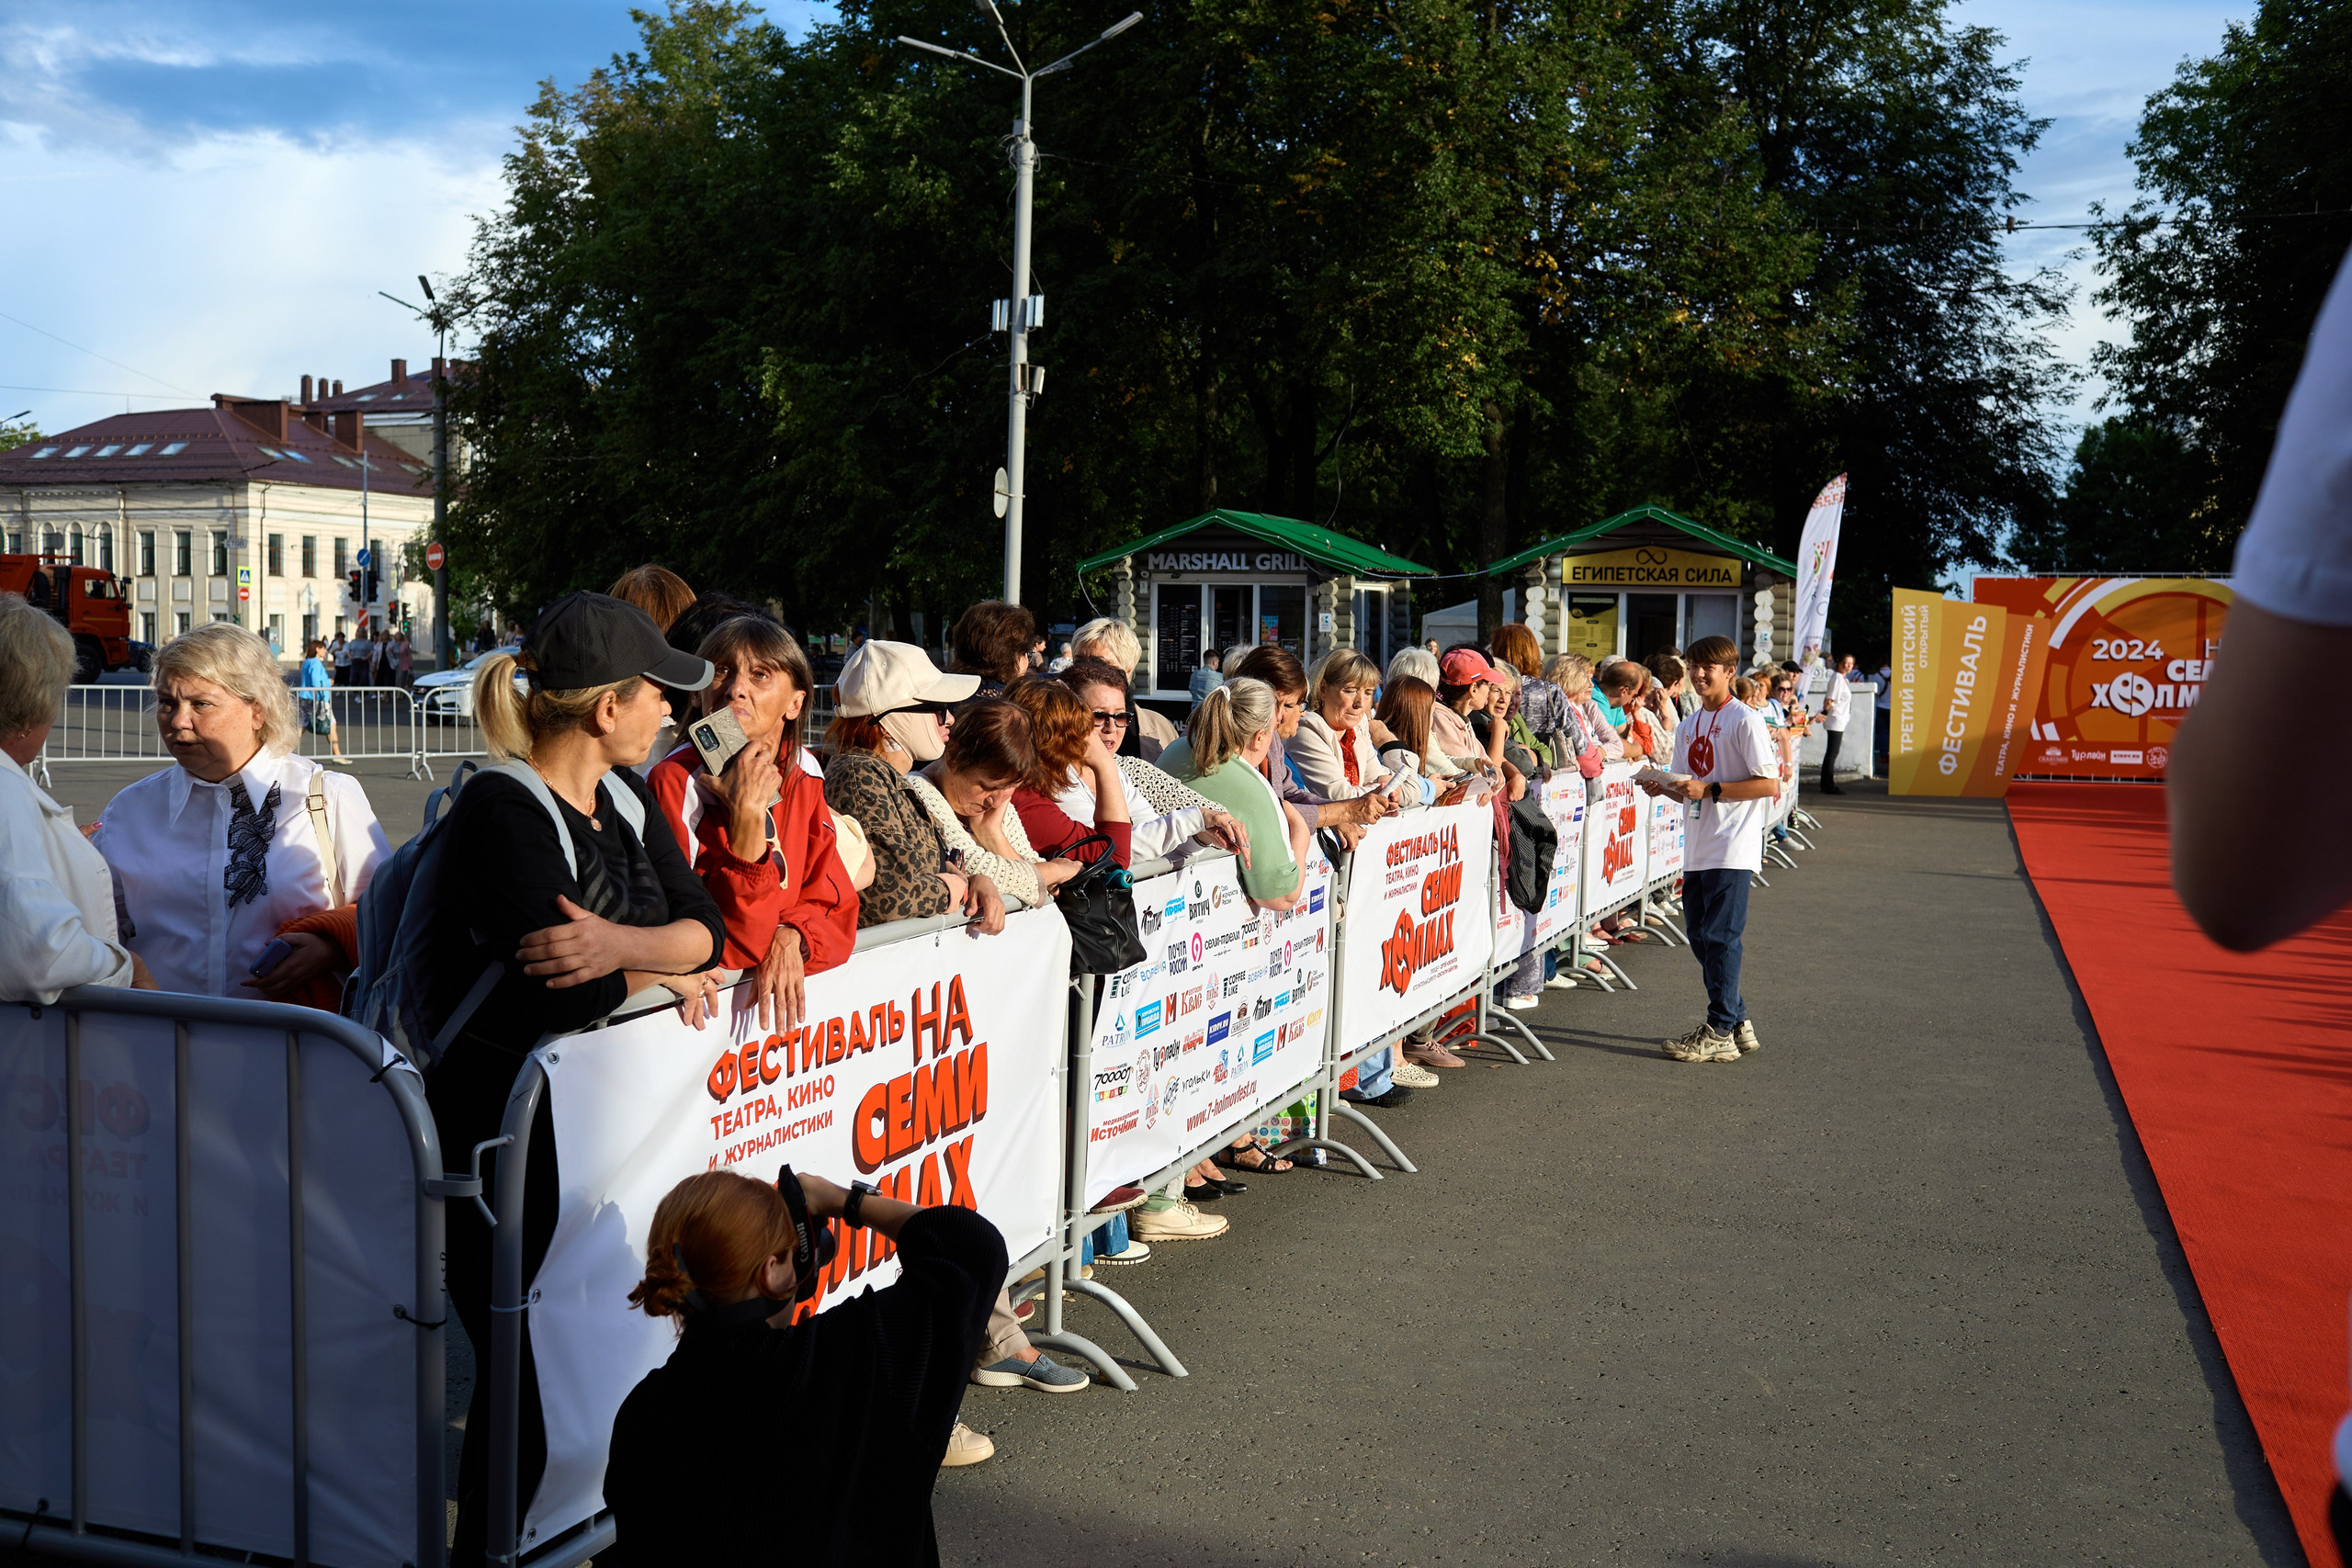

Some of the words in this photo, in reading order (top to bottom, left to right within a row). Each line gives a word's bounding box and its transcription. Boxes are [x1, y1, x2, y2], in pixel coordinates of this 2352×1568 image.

[1148, 553, 1250, 570] MARSHALL
[1255, 553, 1308, 570] GRILL
[1572, 566, 1679, 581] ЕГИПЕТСКАЯ
[1685, 568, 1733, 583] СИЛА
[1900, 604, 1917, 683] ВЯТСКИЙ
[1918, 604, 1929, 669] ОТКРЫТЫЙ
[2092, 638, 2164, 660] 2024
[2011, 624, 2034, 702] ЖУРНАЛИСТИКИ
[1938, 615, 1987, 775] ФЕСТИВАЛЬ
[2009, 704, 2018, 712] И
[1899, 687, 1914, 754] ТРЕТИЙ
[2003, 708, 2016, 739] КИНО
[1995, 738, 2011, 776] ТЕАТРА,
[1618, 804, 1636, 837] СЕМИ
[1386, 831, 1439, 869] ФЕСТИВАЛЬ
[1439, 823, 1460, 868] НА
[1385, 868, 1405, 886] ТЕАТРА,
[1405, 863, 1419, 879] КИНО
[1388, 881, 1419, 900] ЖУРНАЛИСТИКИ
[1421, 861, 1464, 918] СЕМИ
[1188, 898, 1211, 921] ВЯТИЧ
[1168, 940, 1188, 962] ПОЧТА
[1169, 956, 1189, 977] РОССИИ
[1379, 908, 1456, 998] ХОЛМАХ
[1227, 985, 1238, 997] LIKE
[1228, 970, 1246, 986] COFFEE
[707, 998, 906, 1106] ФЕСТИВАЛЬ
[910, 973, 974, 1068] НА
[1102, 1028, 1132, 1047] PATRON
[710, 1094, 784, 1141] ТЕАТРА,
[787, 1074, 836, 1111] КИНО
[852, 1042, 989, 1176] СЕМИ
[1102, 1109, 1139, 1127] медиакомпания
[1186, 1079, 1258, 1133] www.7-holmovfest.ru
[708, 1154, 719, 1172] И
[724, 1110, 833, 1168] ЖУРНАЛИСТИКИ
[1090, 1116, 1139, 1143] Источник
[796, 1222, 809, 1263] Canon
